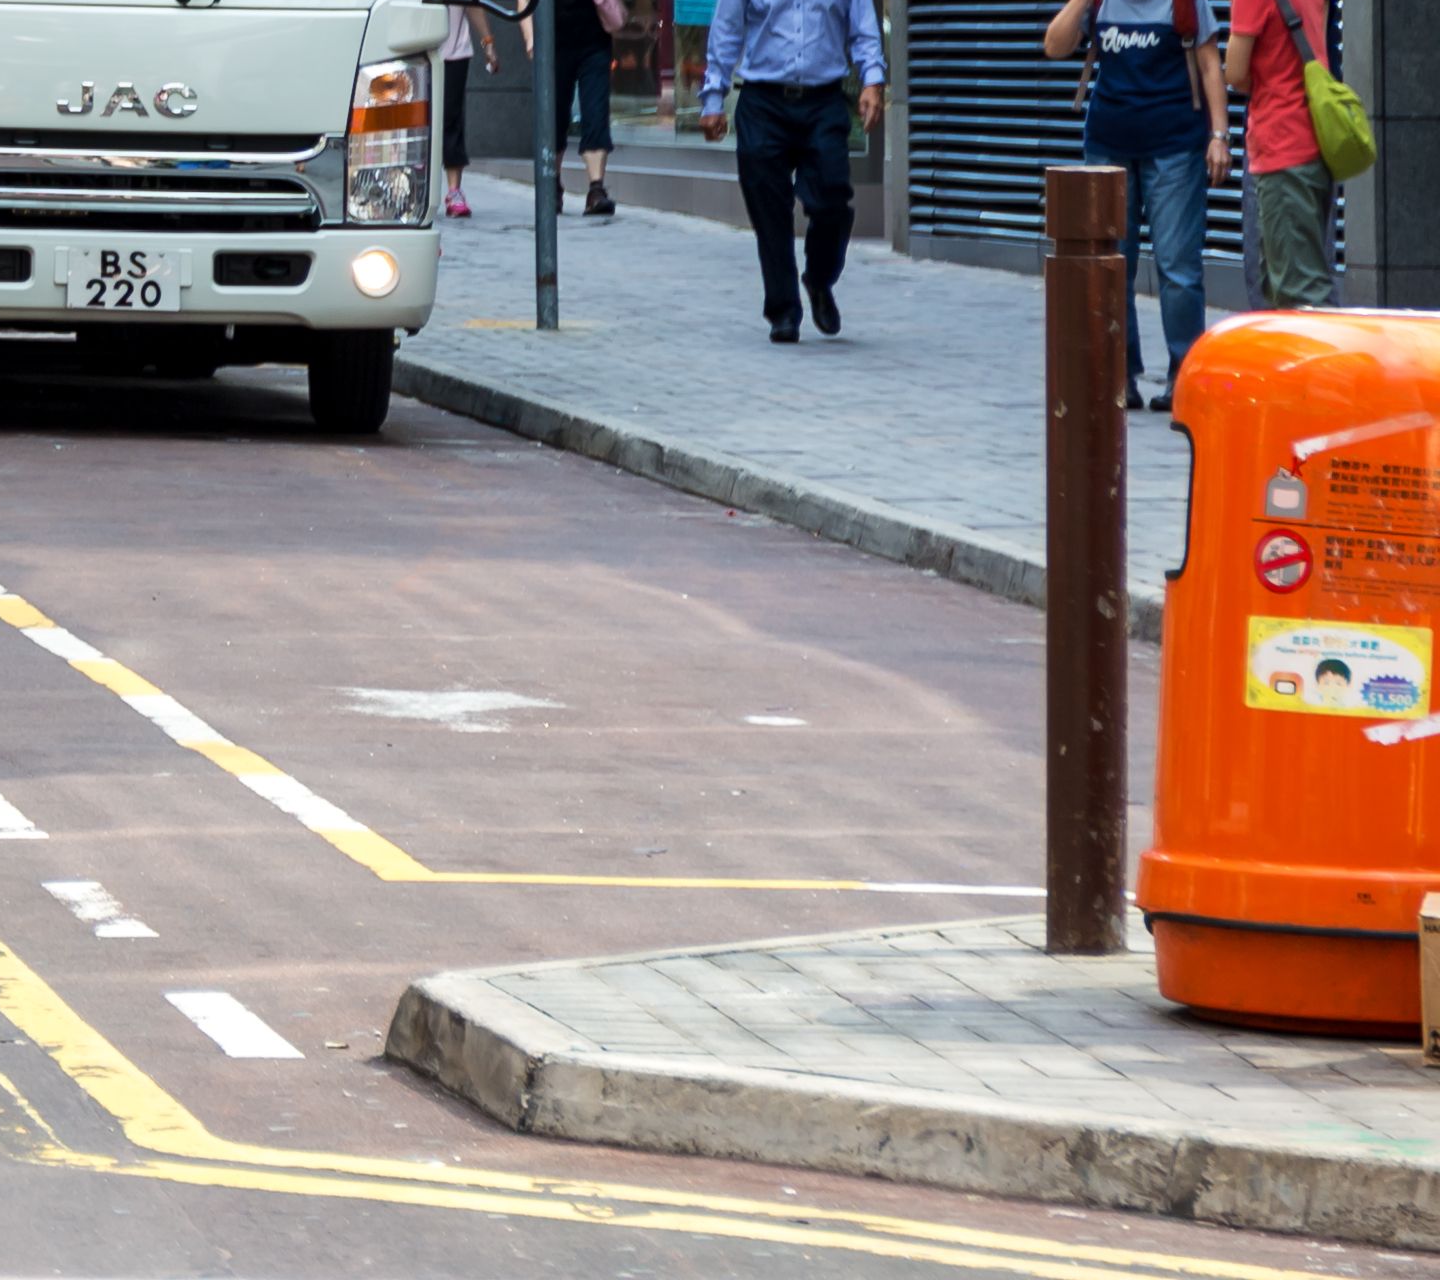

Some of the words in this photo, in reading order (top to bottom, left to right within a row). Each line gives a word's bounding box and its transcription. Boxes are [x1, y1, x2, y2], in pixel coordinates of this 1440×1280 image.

[56, 81, 198, 119] JAC
[100, 249, 148, 279] BS
[85, 278, 162, 308] 220
